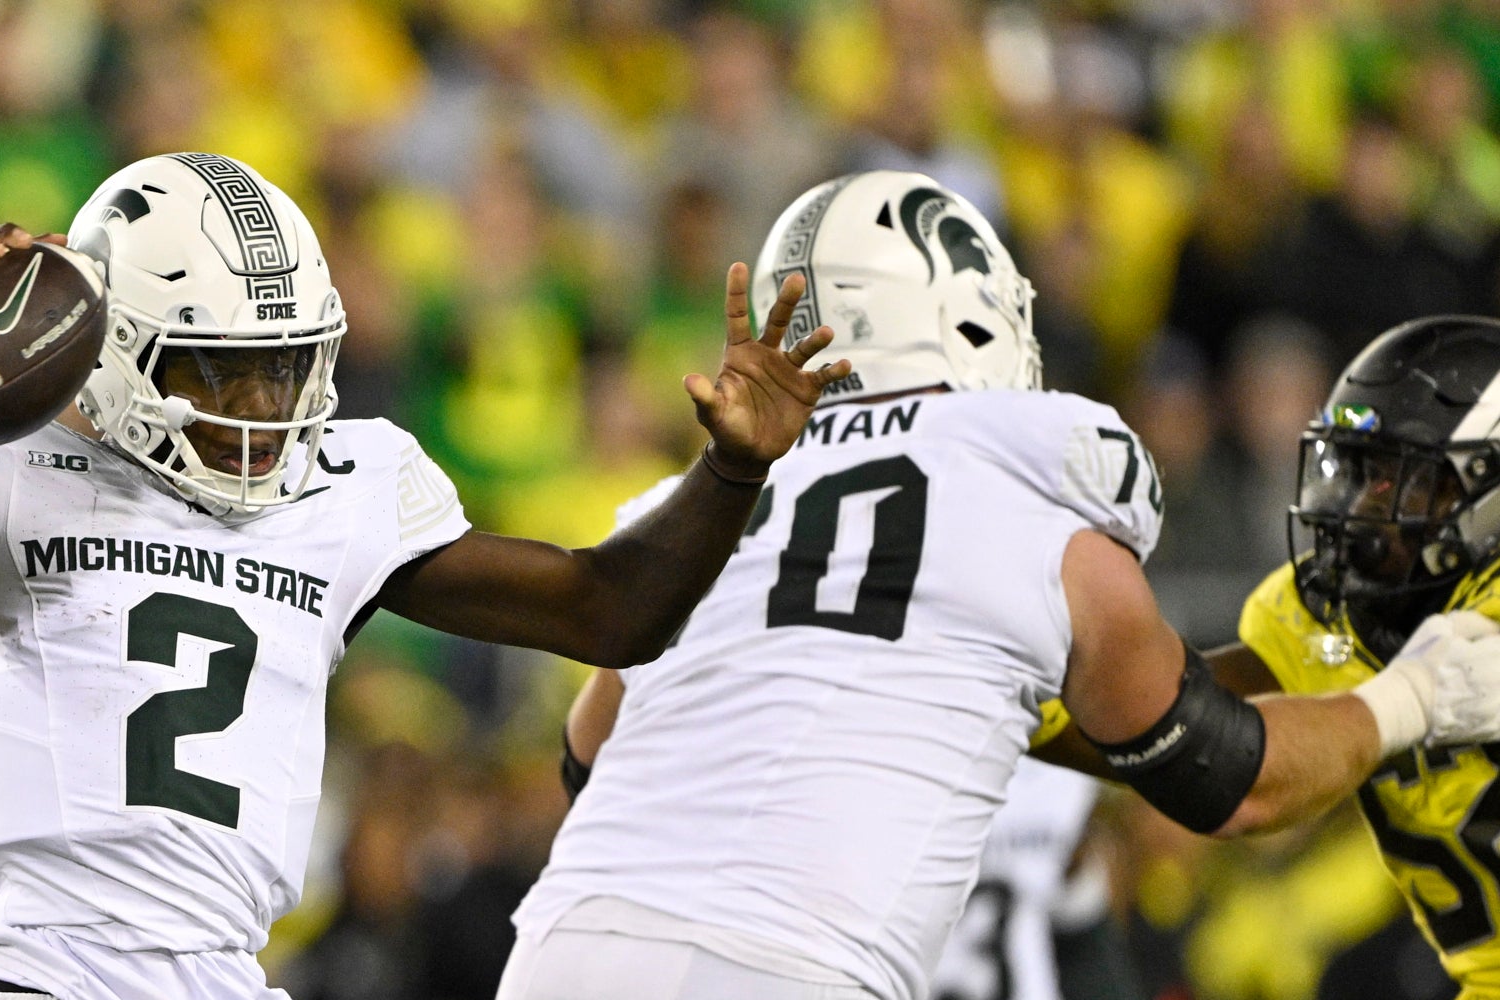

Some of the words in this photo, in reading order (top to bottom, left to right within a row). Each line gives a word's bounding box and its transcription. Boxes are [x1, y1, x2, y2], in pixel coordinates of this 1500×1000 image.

[257, 302, 297, 320] STATE
[20, 536, 225, 588] MICHIGAN
[235, 556, 330, 618] STATE
[125, 591, 259, 831] 2
